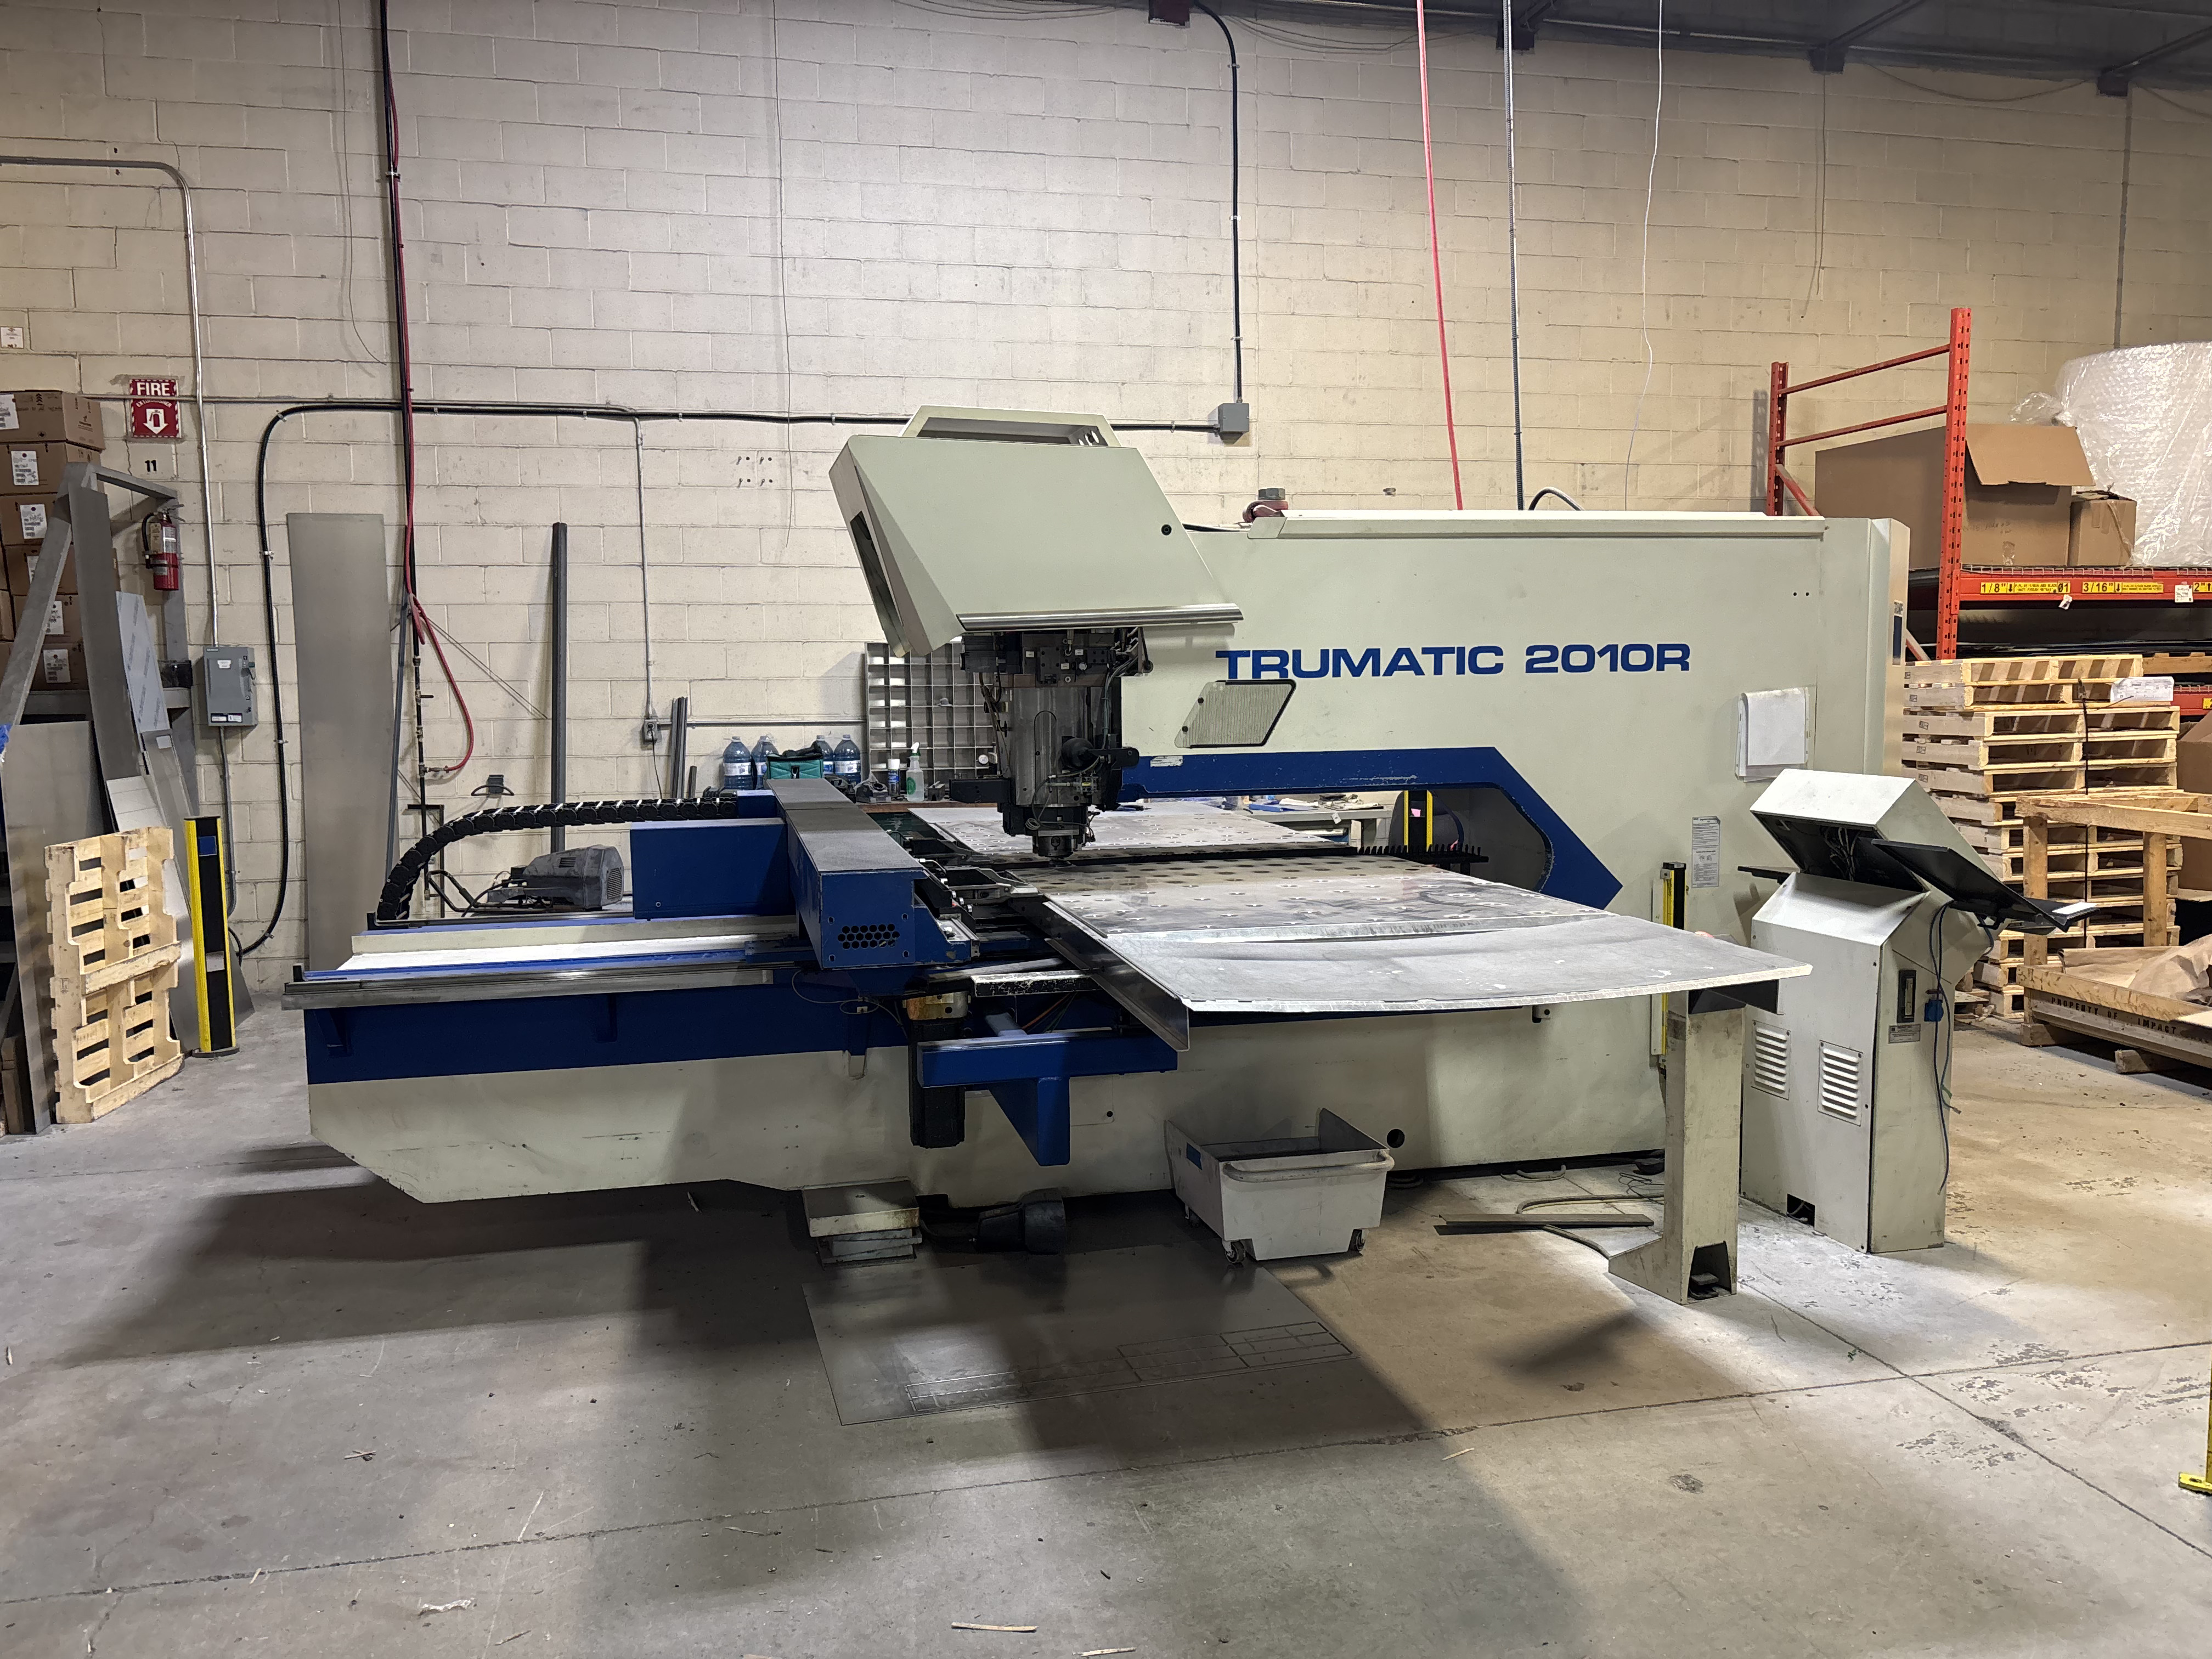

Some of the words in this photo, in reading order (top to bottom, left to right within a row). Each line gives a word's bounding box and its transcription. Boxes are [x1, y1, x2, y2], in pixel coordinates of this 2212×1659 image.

[137, 382, 171, 396] FIRE
[144, 459, 157, 472] 11
[1982, 583, 2006, 593] 1/8"
[2083, 582, 2113, 592] 3/16"
[1215, 645, 1504, 680] TRUMATIC
[1525, 643, 1690, 674] 2010R
